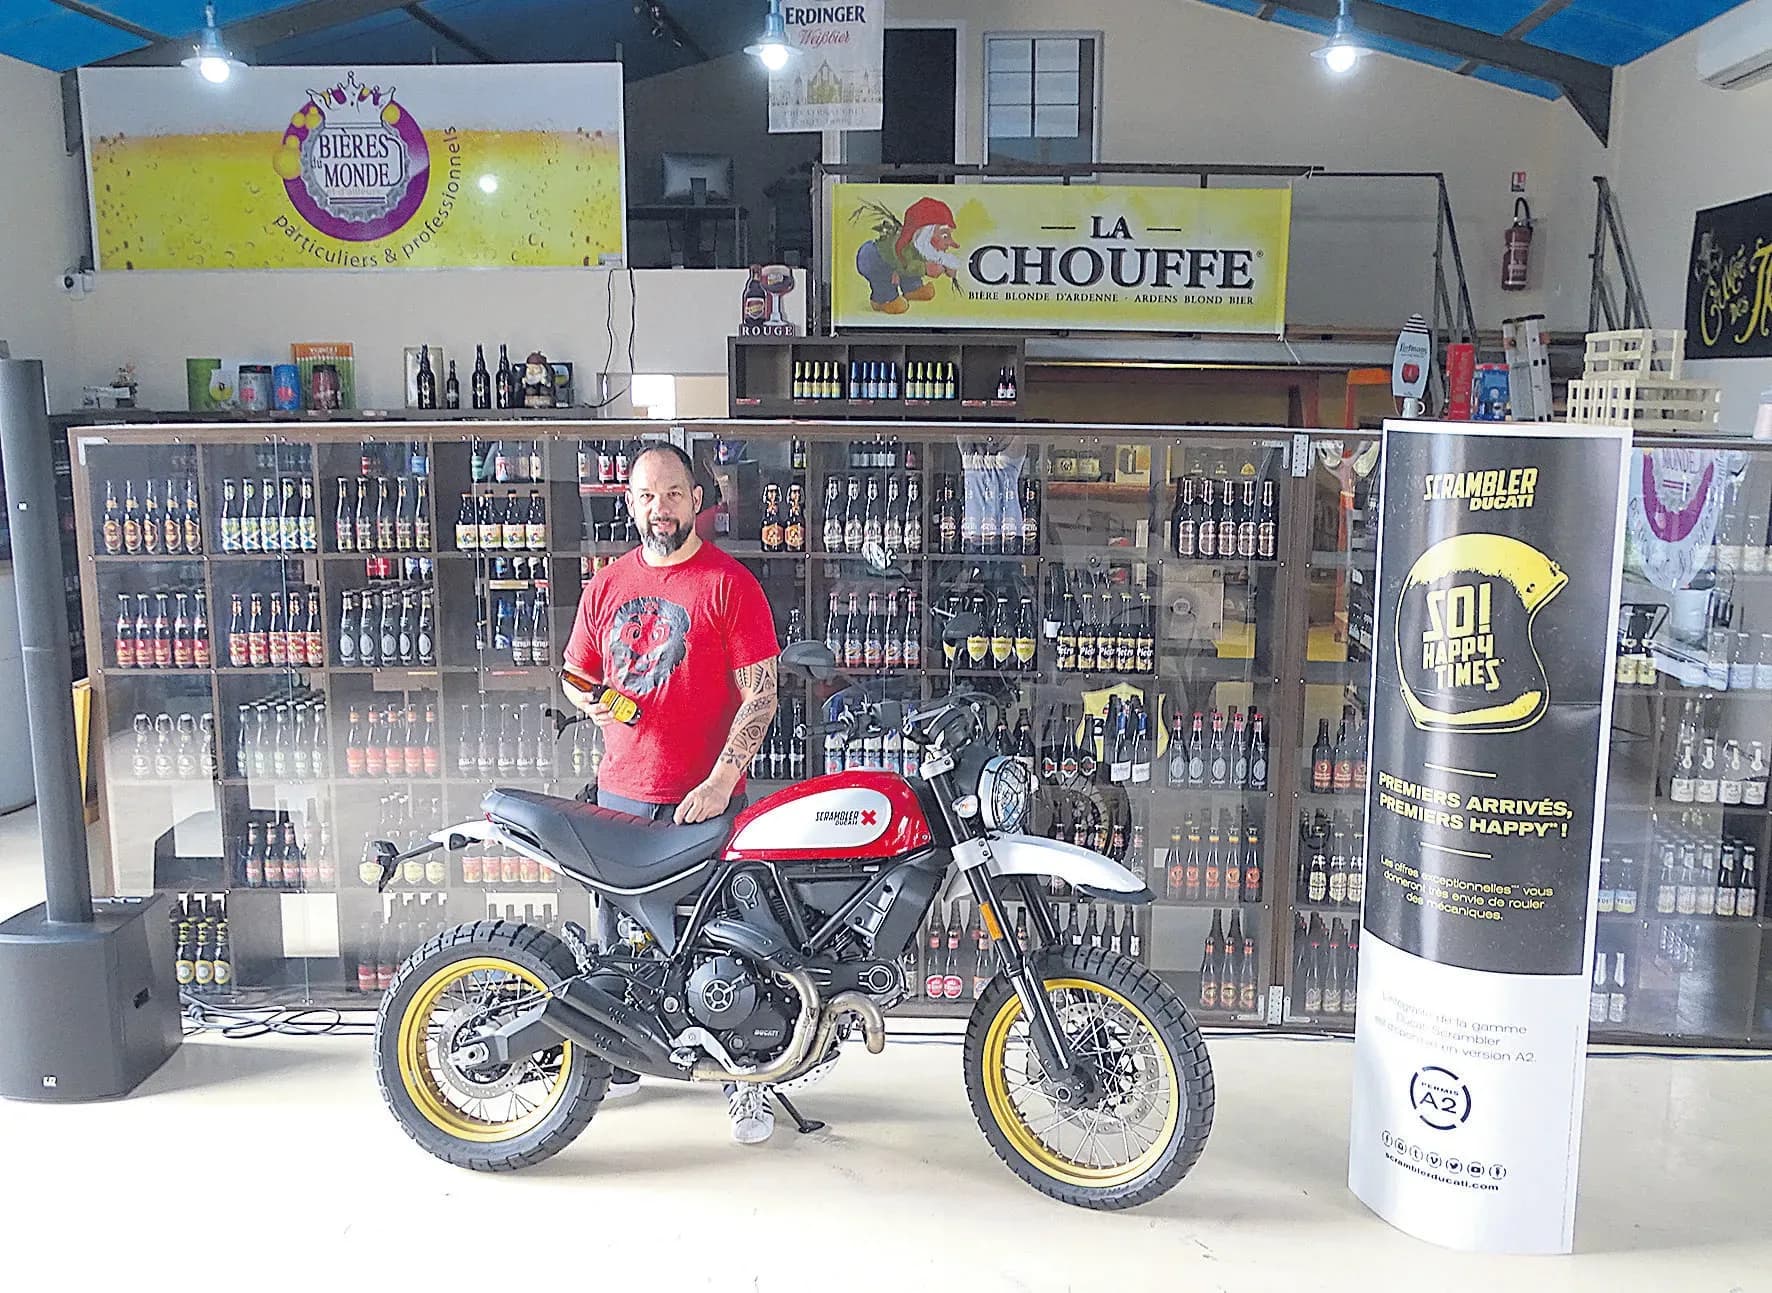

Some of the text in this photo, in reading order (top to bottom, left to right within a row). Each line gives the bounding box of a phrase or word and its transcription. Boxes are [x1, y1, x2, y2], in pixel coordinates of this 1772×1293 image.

[785, 5, 866, 26] ERDINGER
[319, 128, 389, 158] BIÈRES
[325, 163, 390, 188] MONDE
[273, 126, 461, 268] particuliers & professionnels
[1090, 216, 1134, 239] LA
[968, 245, 1255, 290] CHOUFFE
[969, 291, 1254, 305] BIÈRE BLONDE D'ARDENNE ARDENS BLOND BIER
[742, 326, 793, 336] ROUGE
[1423, 468, 1538, 500] SCRAMBLER
[1469, 495, 1535, 511] DUCATI
[1423, 583, 1492, 642] SO!
[1422, 634, 1494, 669] HAPPY
[1378, 771, 1461, 809] PREMIERS
[1466, 797, 1573, 819] ARRIVÉS,
[815, 811, 859, 822] SCRAMBLER
[1379, 792, 1464, 830] PREMIERS
[1380, 854, 1394, 868] Les
[1395, 862, 1419, 878] offres
[1523, 886, 1554, 896] vous
[1383, 870, 1426, 893] donneront
[1452, 892, 1485, 905] envie
[1488, 896, 1504, 907] de
[1508, 898, 1545, 909] rouler
[1406, 893, 1503, 921] des mécaniques.
[754, 1029, 779, 1037] DUCATI
[1432, 1026, 1500, 1047] Scrambler
[1471, 1021, 1527, 1035] gamme
[1462, 1046, 1511, 1062] version
[1419, 1091, 1457, 1114] A2
[1385, 1152, 1499, 1191] scramblerducati.com
